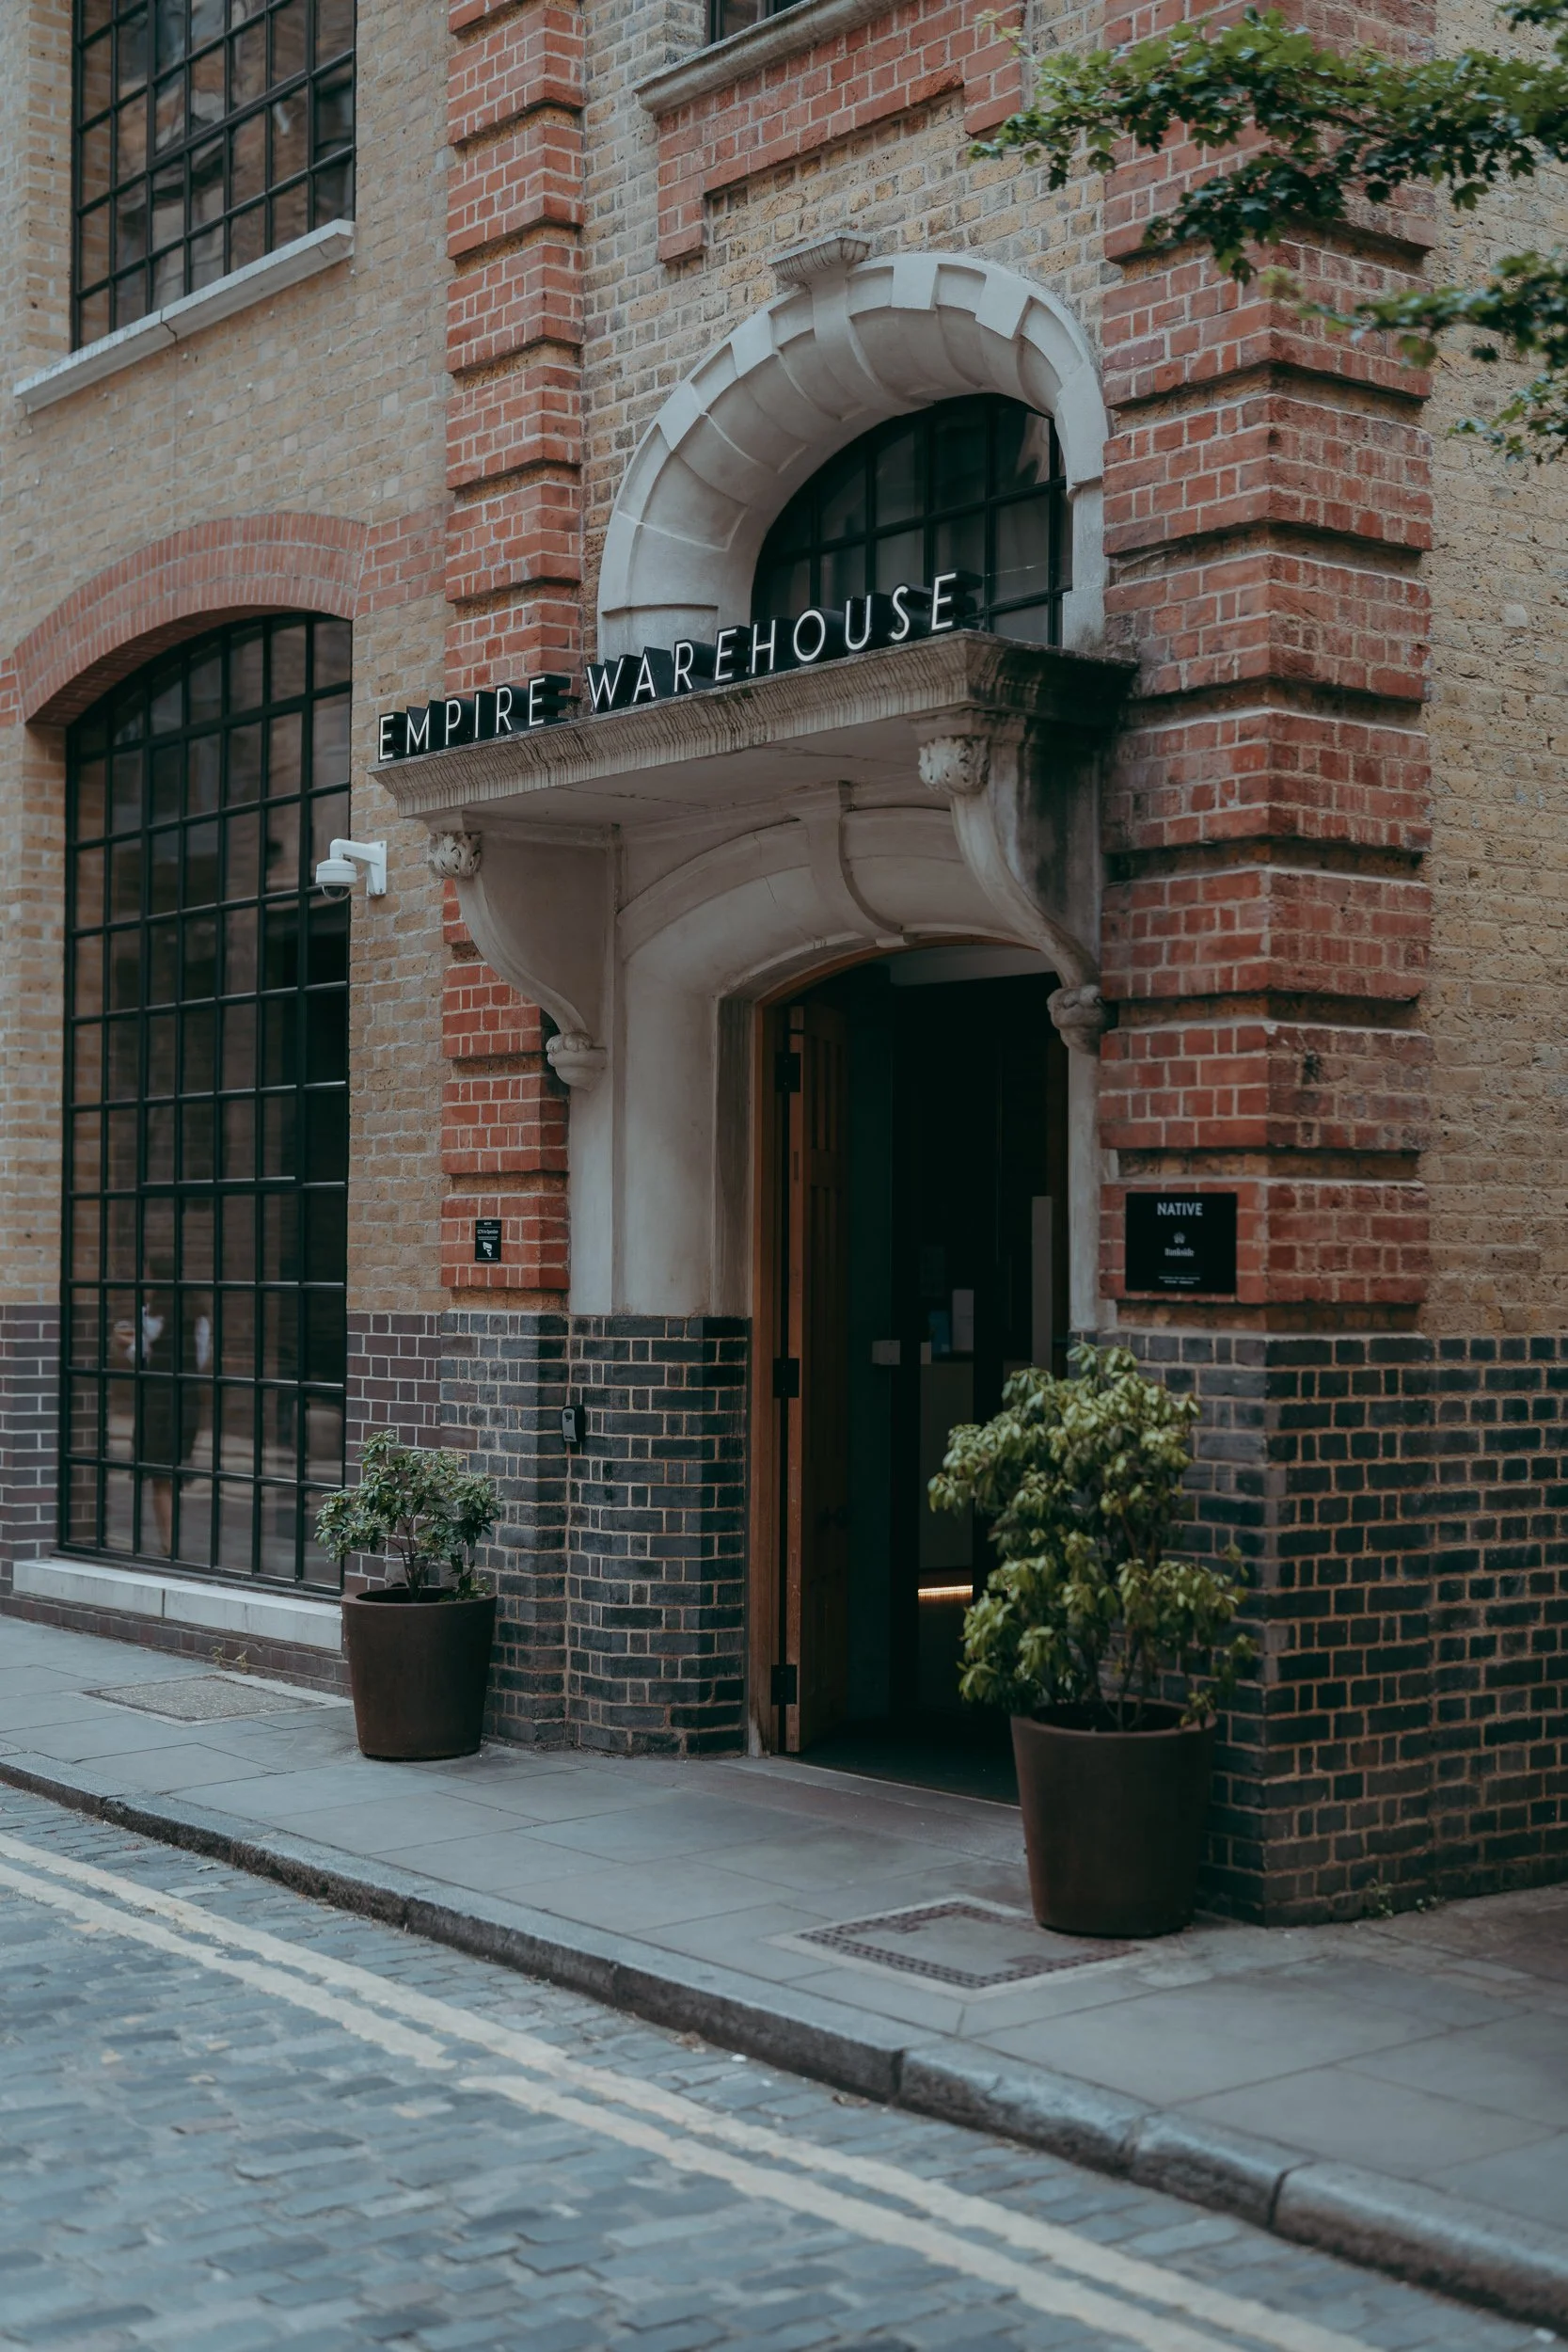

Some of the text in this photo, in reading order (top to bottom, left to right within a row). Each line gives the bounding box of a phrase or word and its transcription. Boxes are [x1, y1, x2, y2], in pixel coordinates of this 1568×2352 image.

[378, 571, 958, 761] EMPIRE WAREHOUSE
[1157, 1202, 1203, 1216] NATIVE
